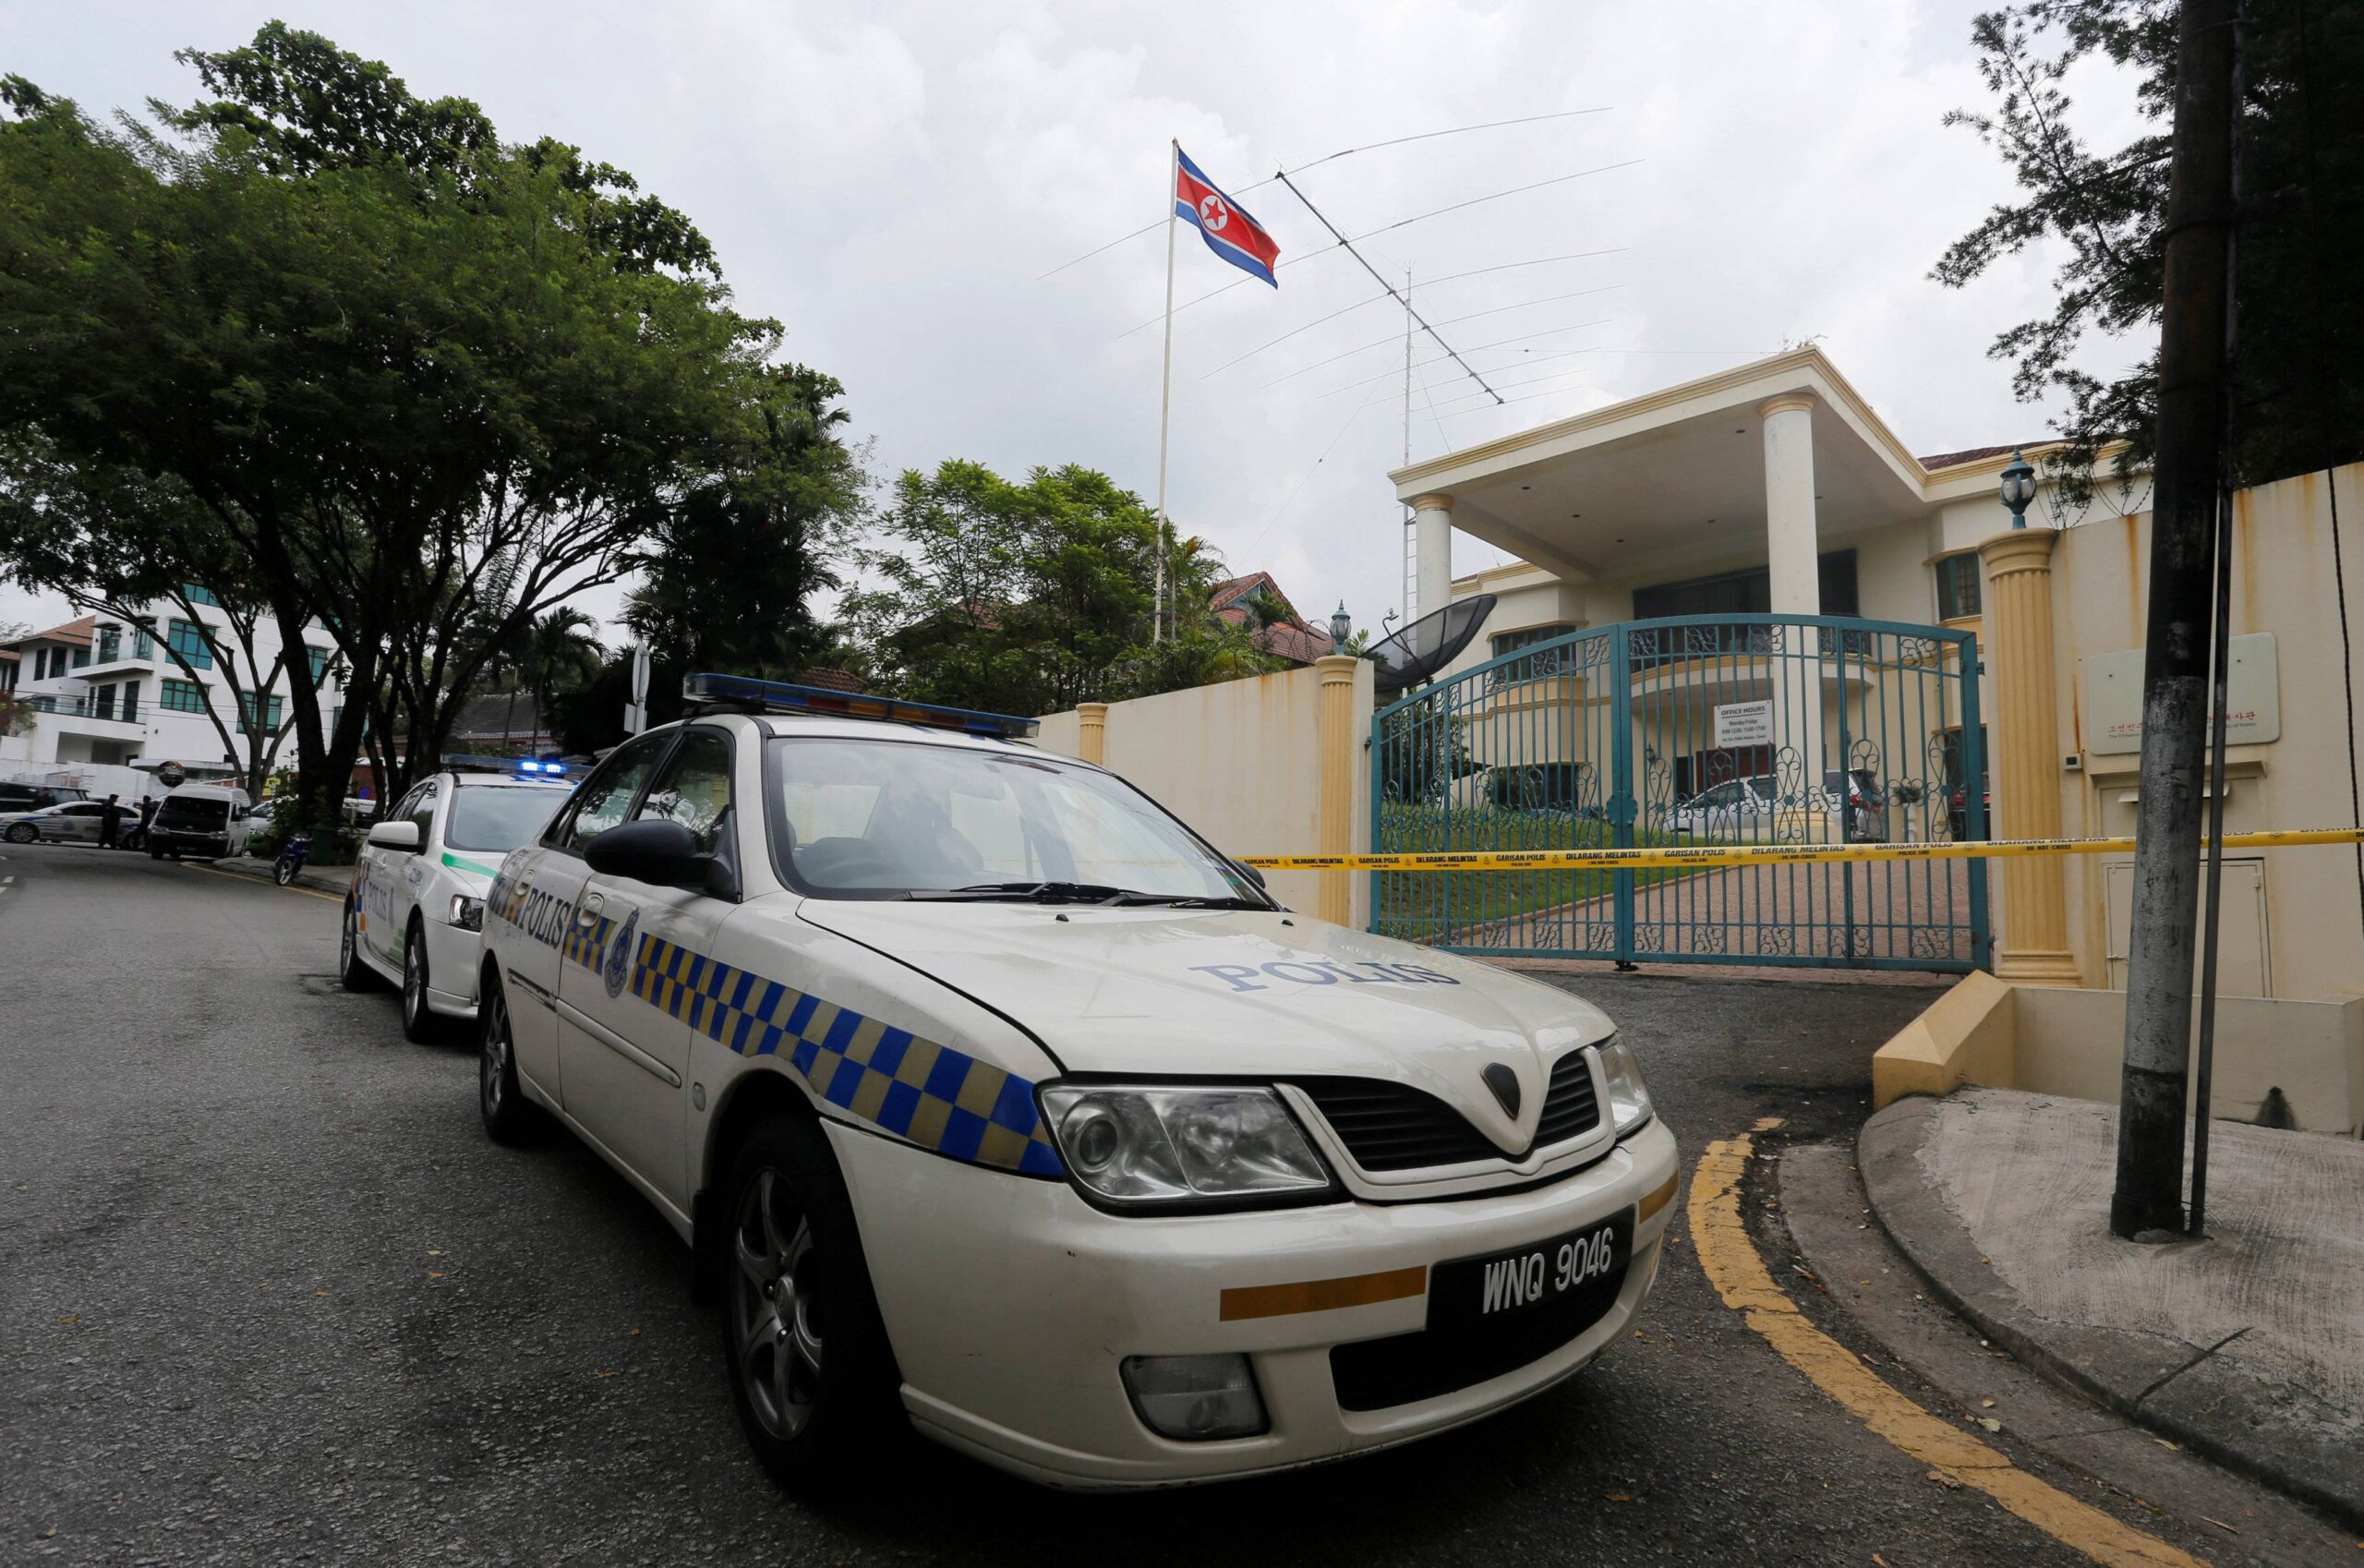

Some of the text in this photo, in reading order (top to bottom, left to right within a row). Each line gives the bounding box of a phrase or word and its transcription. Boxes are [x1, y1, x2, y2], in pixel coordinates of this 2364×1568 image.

[1664, 849, 1726, 858] GARISAN POLIS
[1752, 845, 1846, 855] DILARANG MELINTAS
[1416, 855, 1446, 863] DILARANG
[1495, 854, 1525, 862] GARISAN
[1565, 850, 1642, 861] DILARANG MELINTAS
[518, 887, 573, 950] POLIS
[1187, 961, 1461, 993] POLIS
[1482, 1227, 1613, 1314] WNQ 9046
